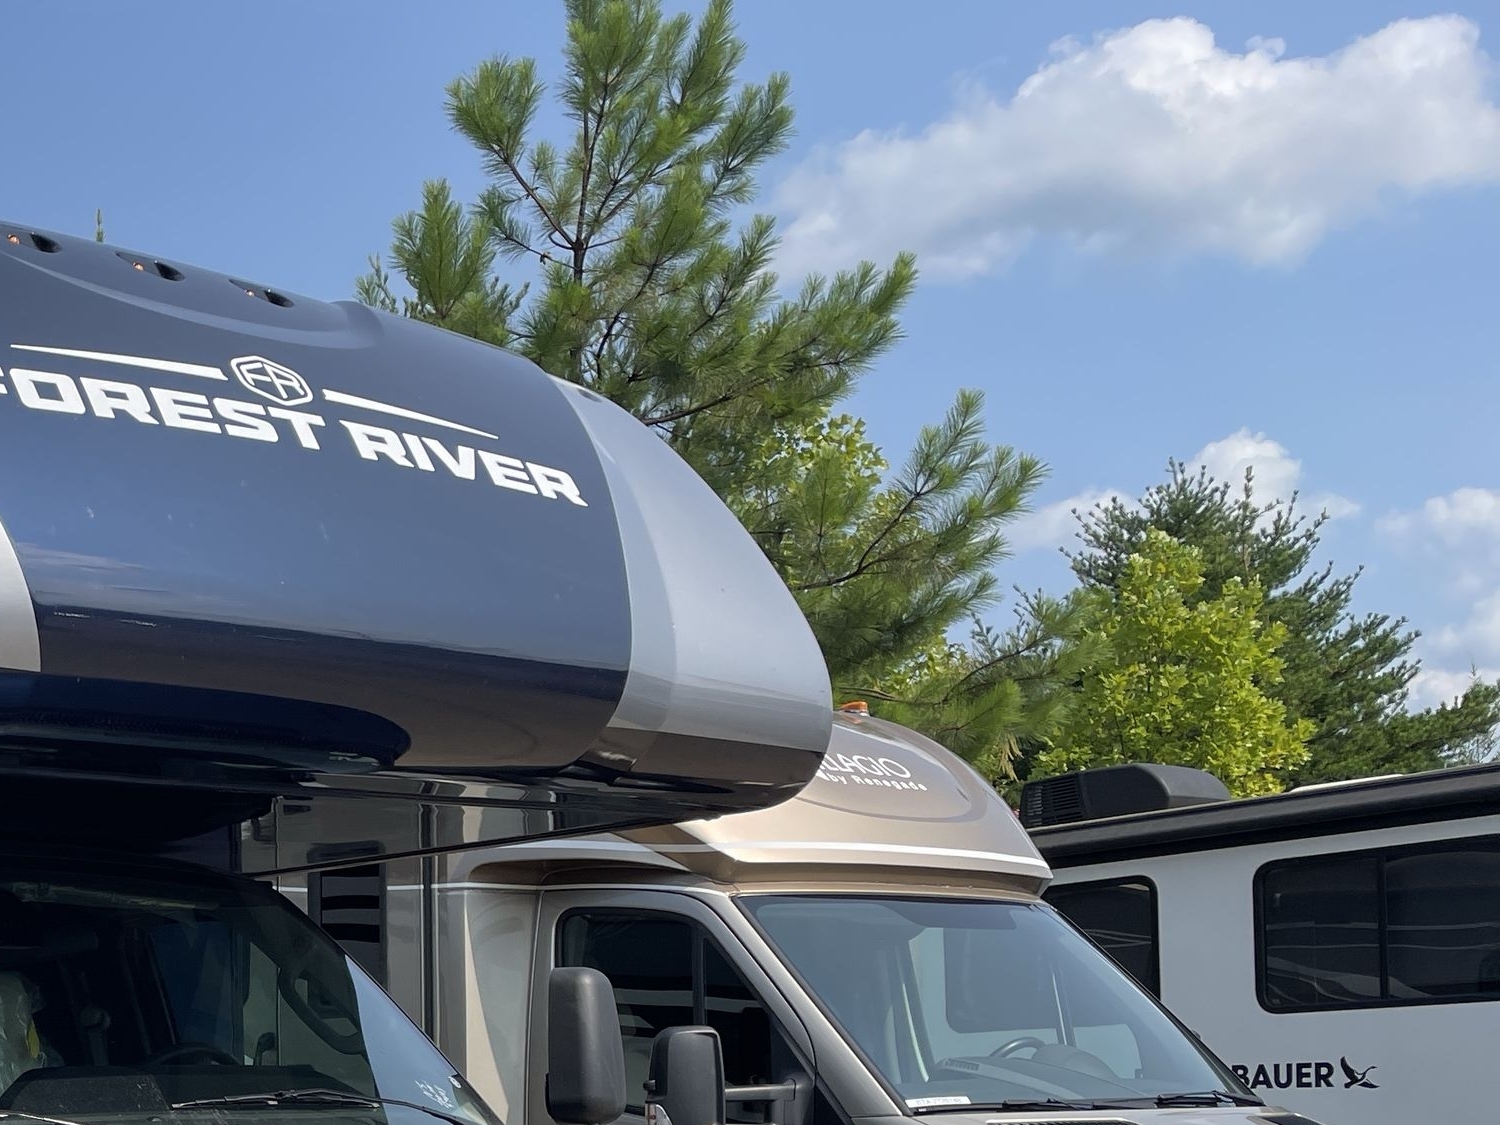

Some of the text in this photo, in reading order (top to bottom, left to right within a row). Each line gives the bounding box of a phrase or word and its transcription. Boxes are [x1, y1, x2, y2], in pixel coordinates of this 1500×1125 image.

[339, 419, 589, 507] RIVER
[820, 753, 912, 779] LLAGIO
[850, 774, 928, 791] Renegade
[1231, 1061, 1335, 1089] BAUER
